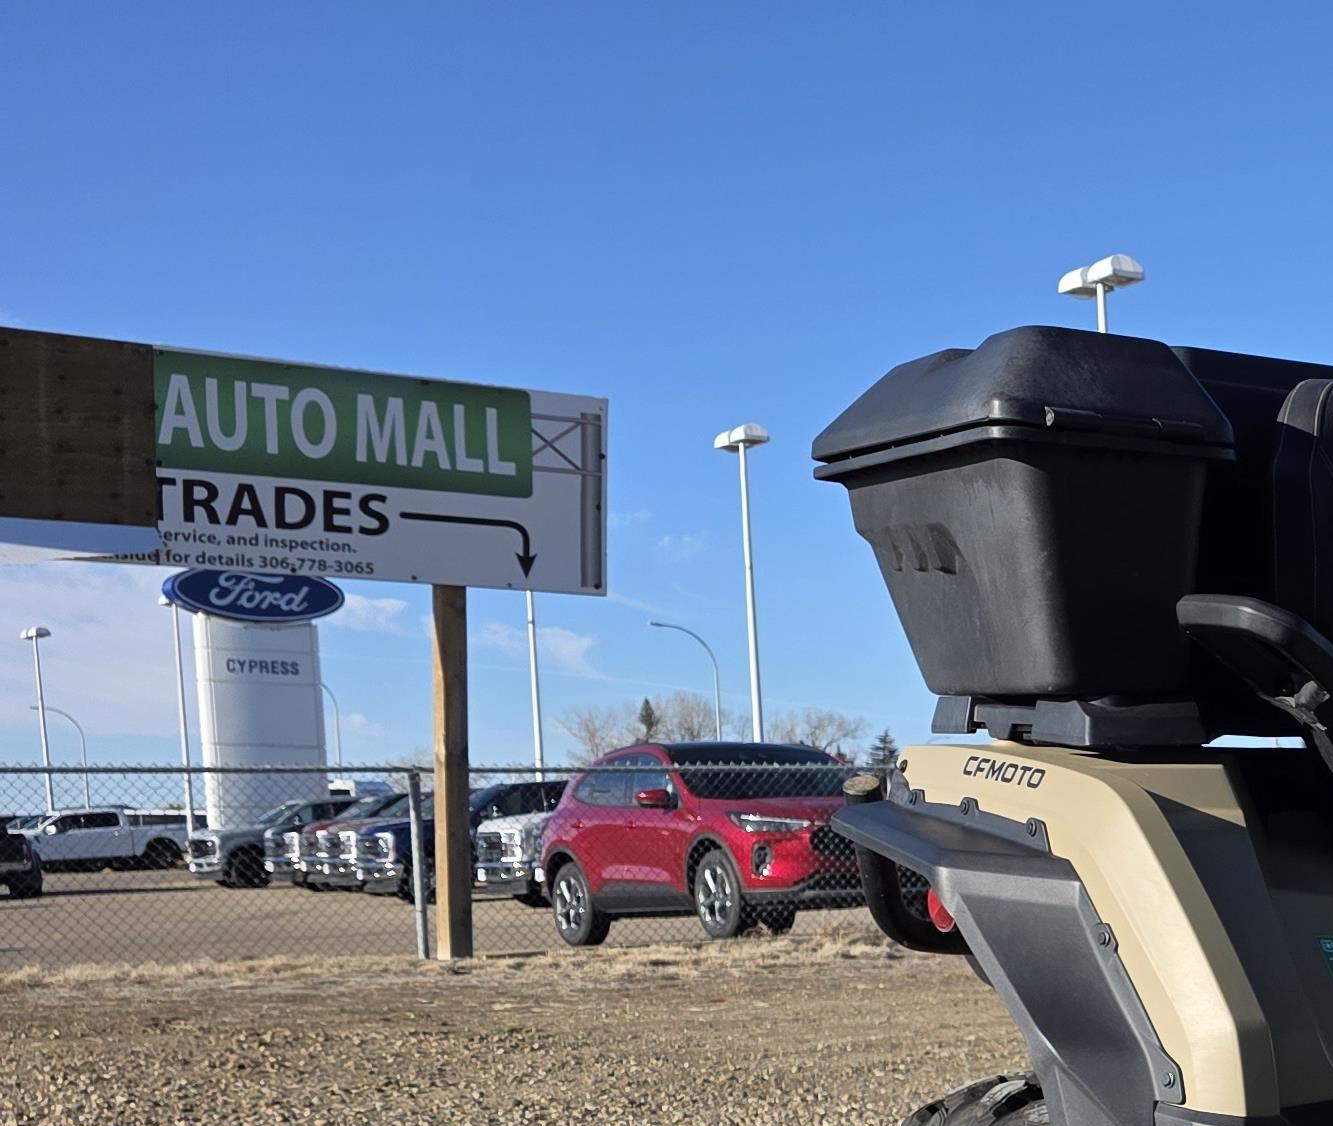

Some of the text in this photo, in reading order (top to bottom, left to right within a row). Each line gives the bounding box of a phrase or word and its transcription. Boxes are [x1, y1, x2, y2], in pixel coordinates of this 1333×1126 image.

[158, 373, 516, 476] AUTO MALL
[226, 533, 259, 547] and
[264, 534, 357, 553] inspection.
[165, 549, 191, 563] for
[195, 550, 254, 567] details
[209, 571, 310, 612] Ford
[226, 658, 299, 676] CYPRESS
[963, 755, 1046, 789] CFMOTO
